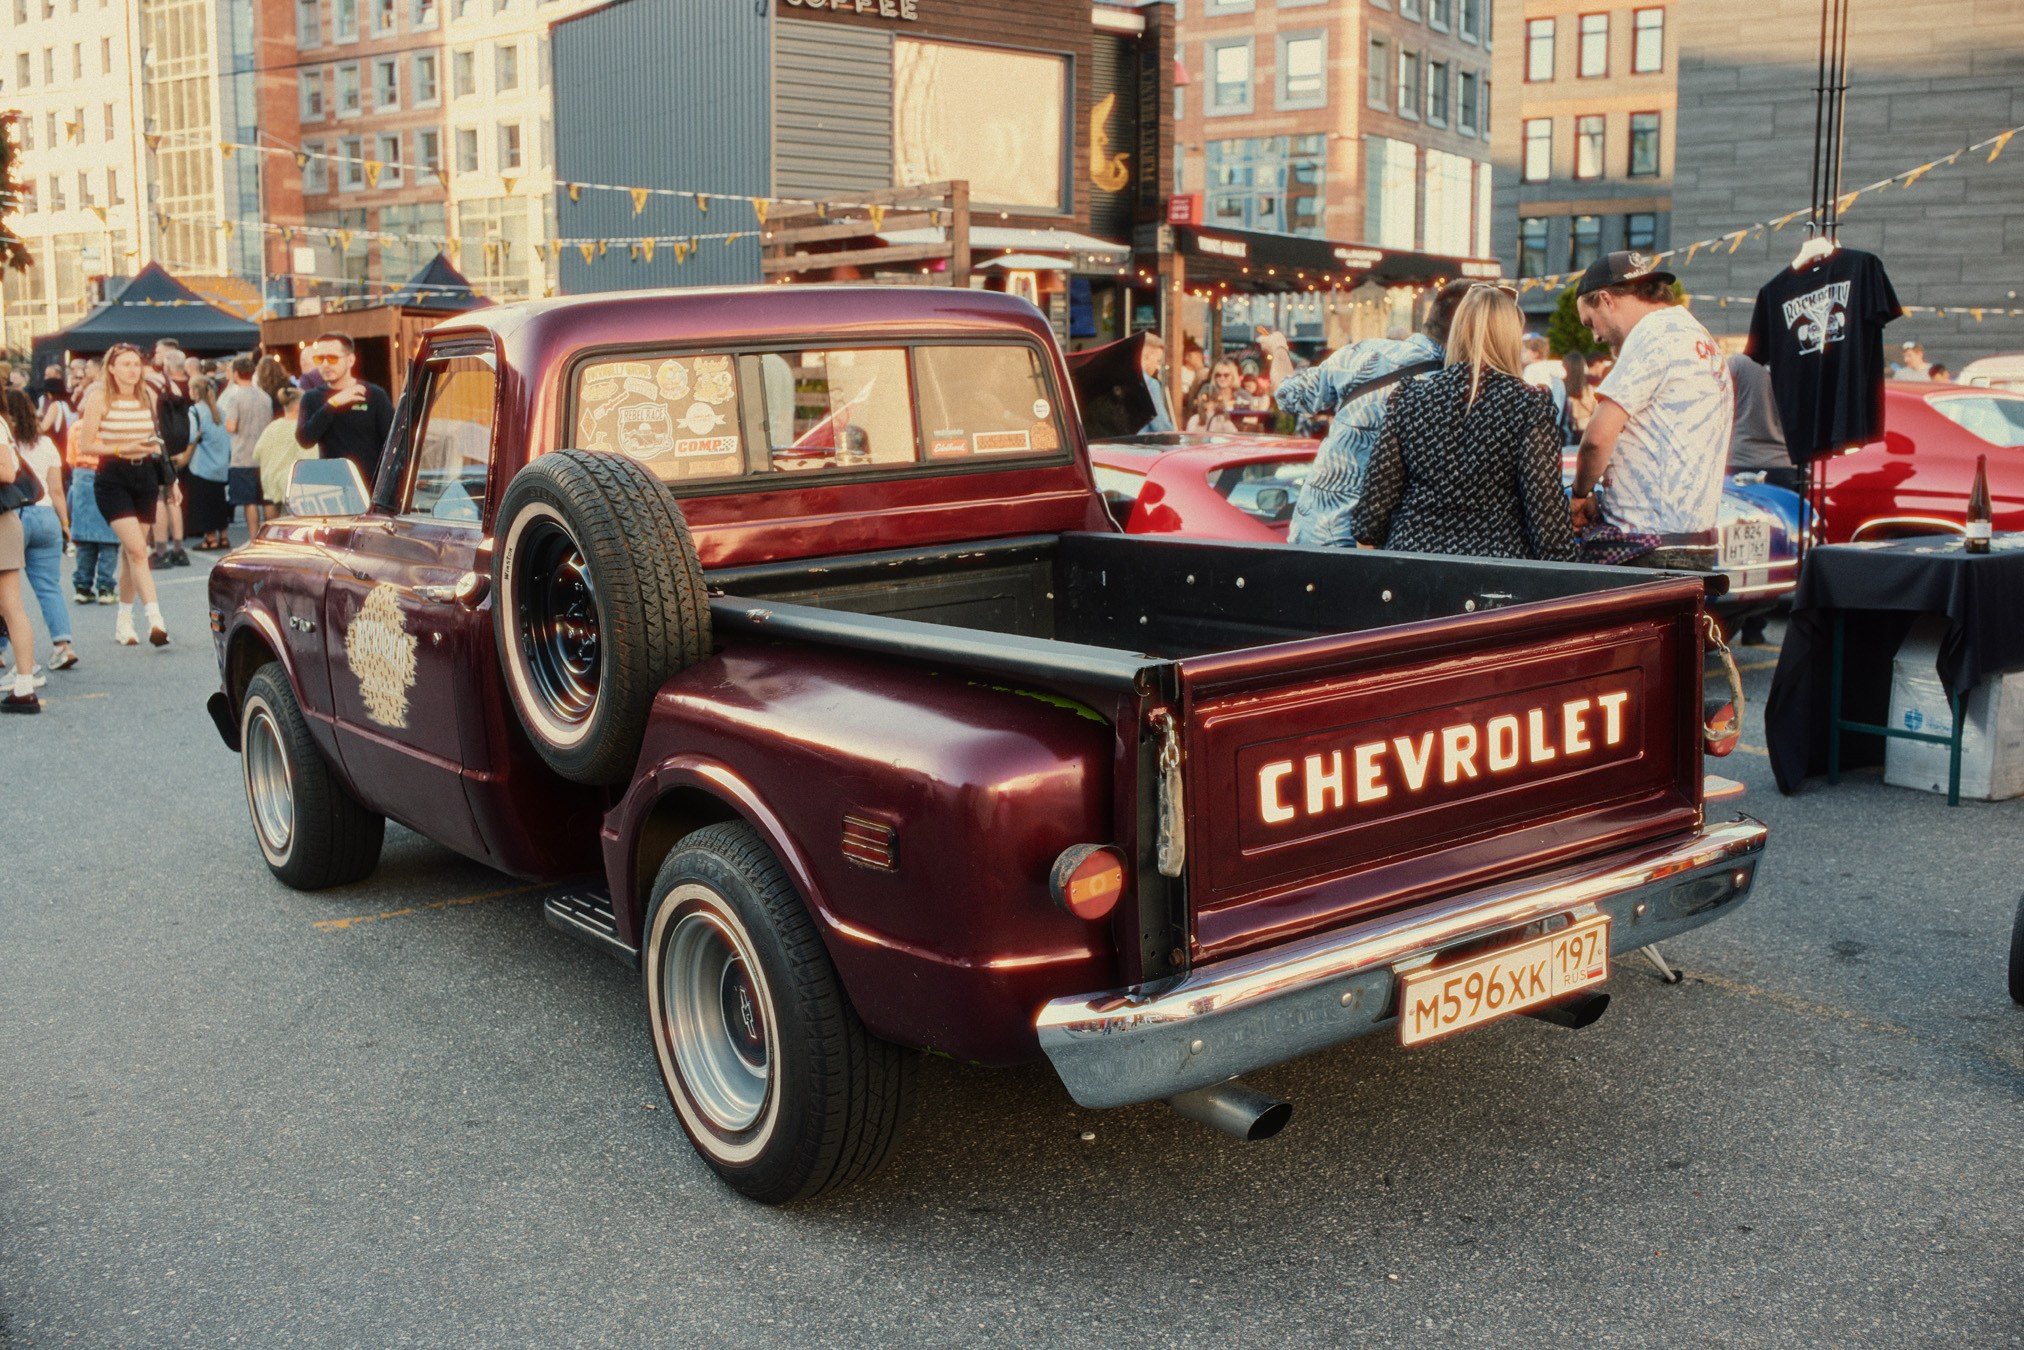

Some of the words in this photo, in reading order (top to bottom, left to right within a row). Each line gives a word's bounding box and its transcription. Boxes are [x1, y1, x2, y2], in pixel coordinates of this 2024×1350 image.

[786, 0, 919, 20] FEE
[624, 409, 645, 421] REBEL
[646, 408, 664, 420] RACE
[678, 440, 722, 453] COMP
[1258, 691, 1628, 824] CHEVROLET
[1415, 959, 1547, 1034] M596XK
[1555, 929, 1598, 974] 197
[1564, 969, 1587, 986] RUS
